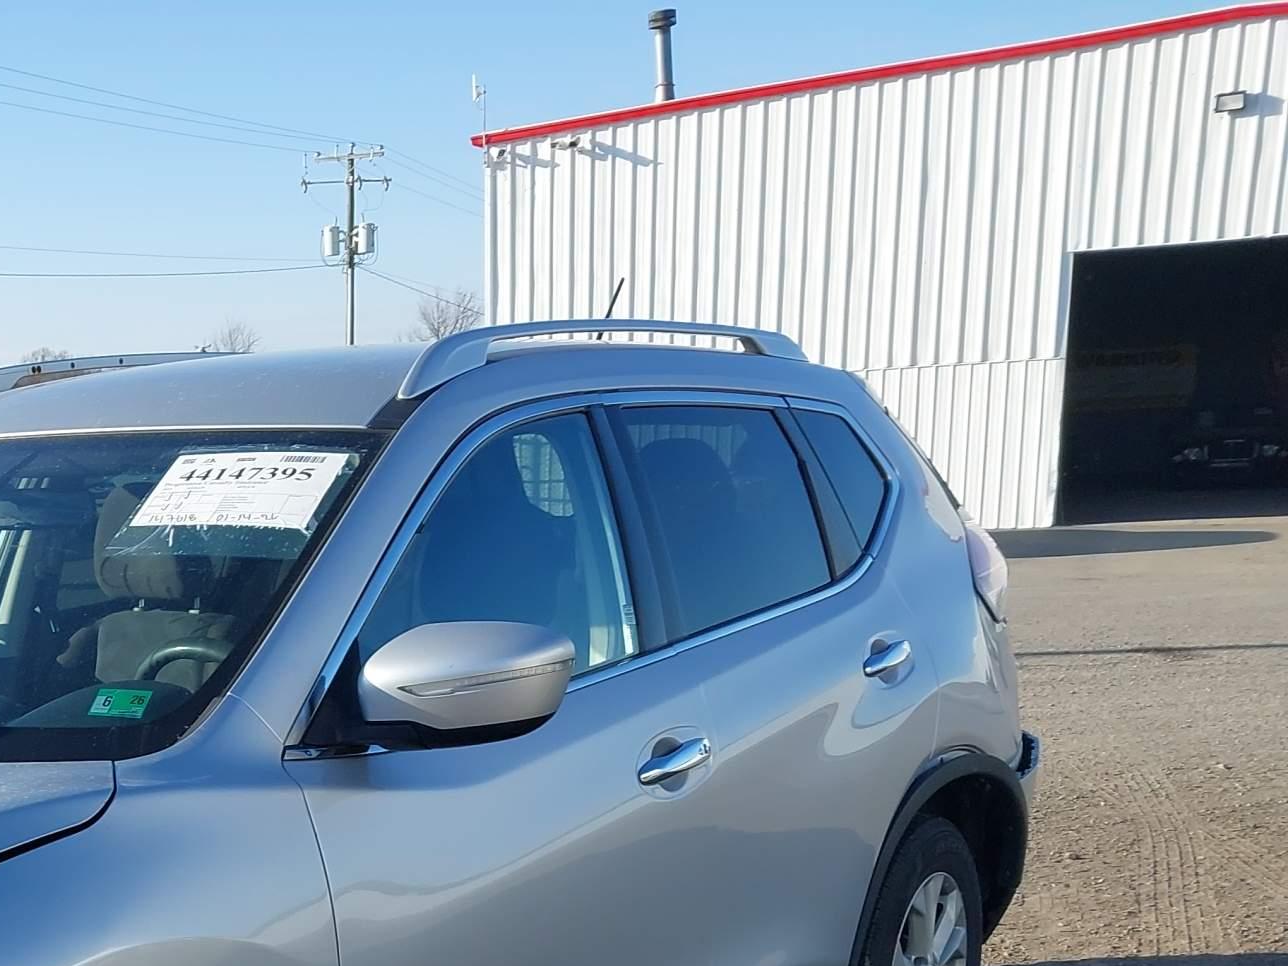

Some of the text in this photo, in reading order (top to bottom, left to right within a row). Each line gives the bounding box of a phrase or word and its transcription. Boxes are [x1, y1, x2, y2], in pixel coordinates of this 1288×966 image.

[180, 467, 316, 481] 44147395
[102, 695, 145, 707] 6 26
